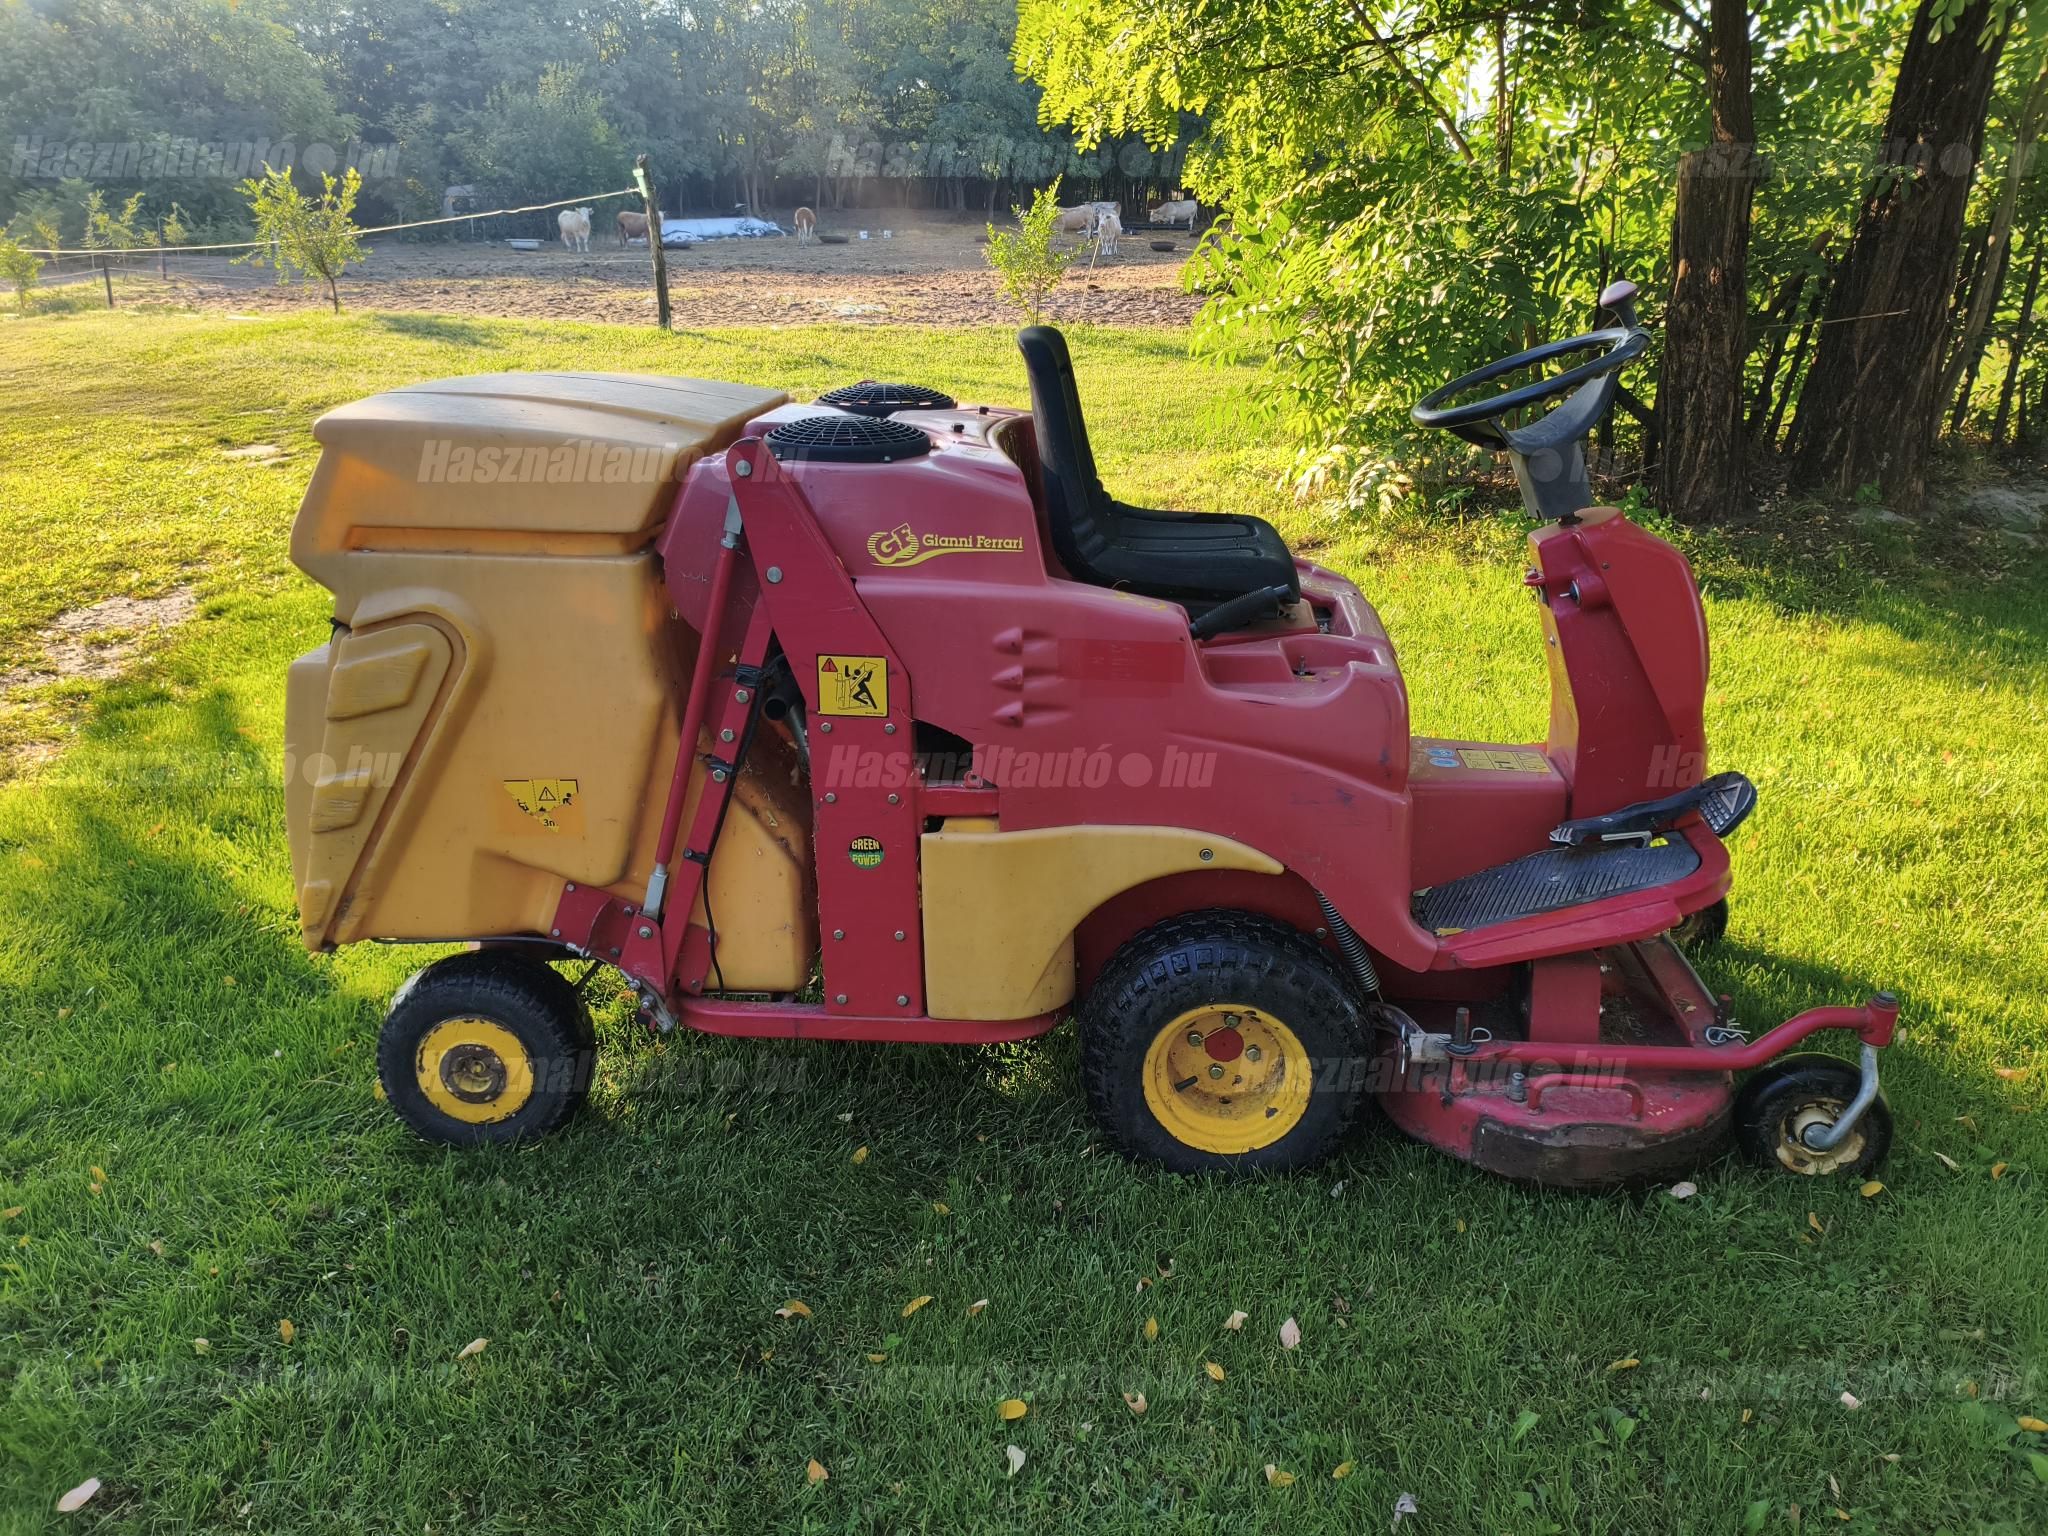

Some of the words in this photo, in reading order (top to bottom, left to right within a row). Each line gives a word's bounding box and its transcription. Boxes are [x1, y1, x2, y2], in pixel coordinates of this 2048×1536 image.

[922, 533, 973, 548] Gianni
[976, 535, 1024, 549] Ferrari
[851, 838, 880, 850] GREEN
[852, 854, 881, 866] POWER
